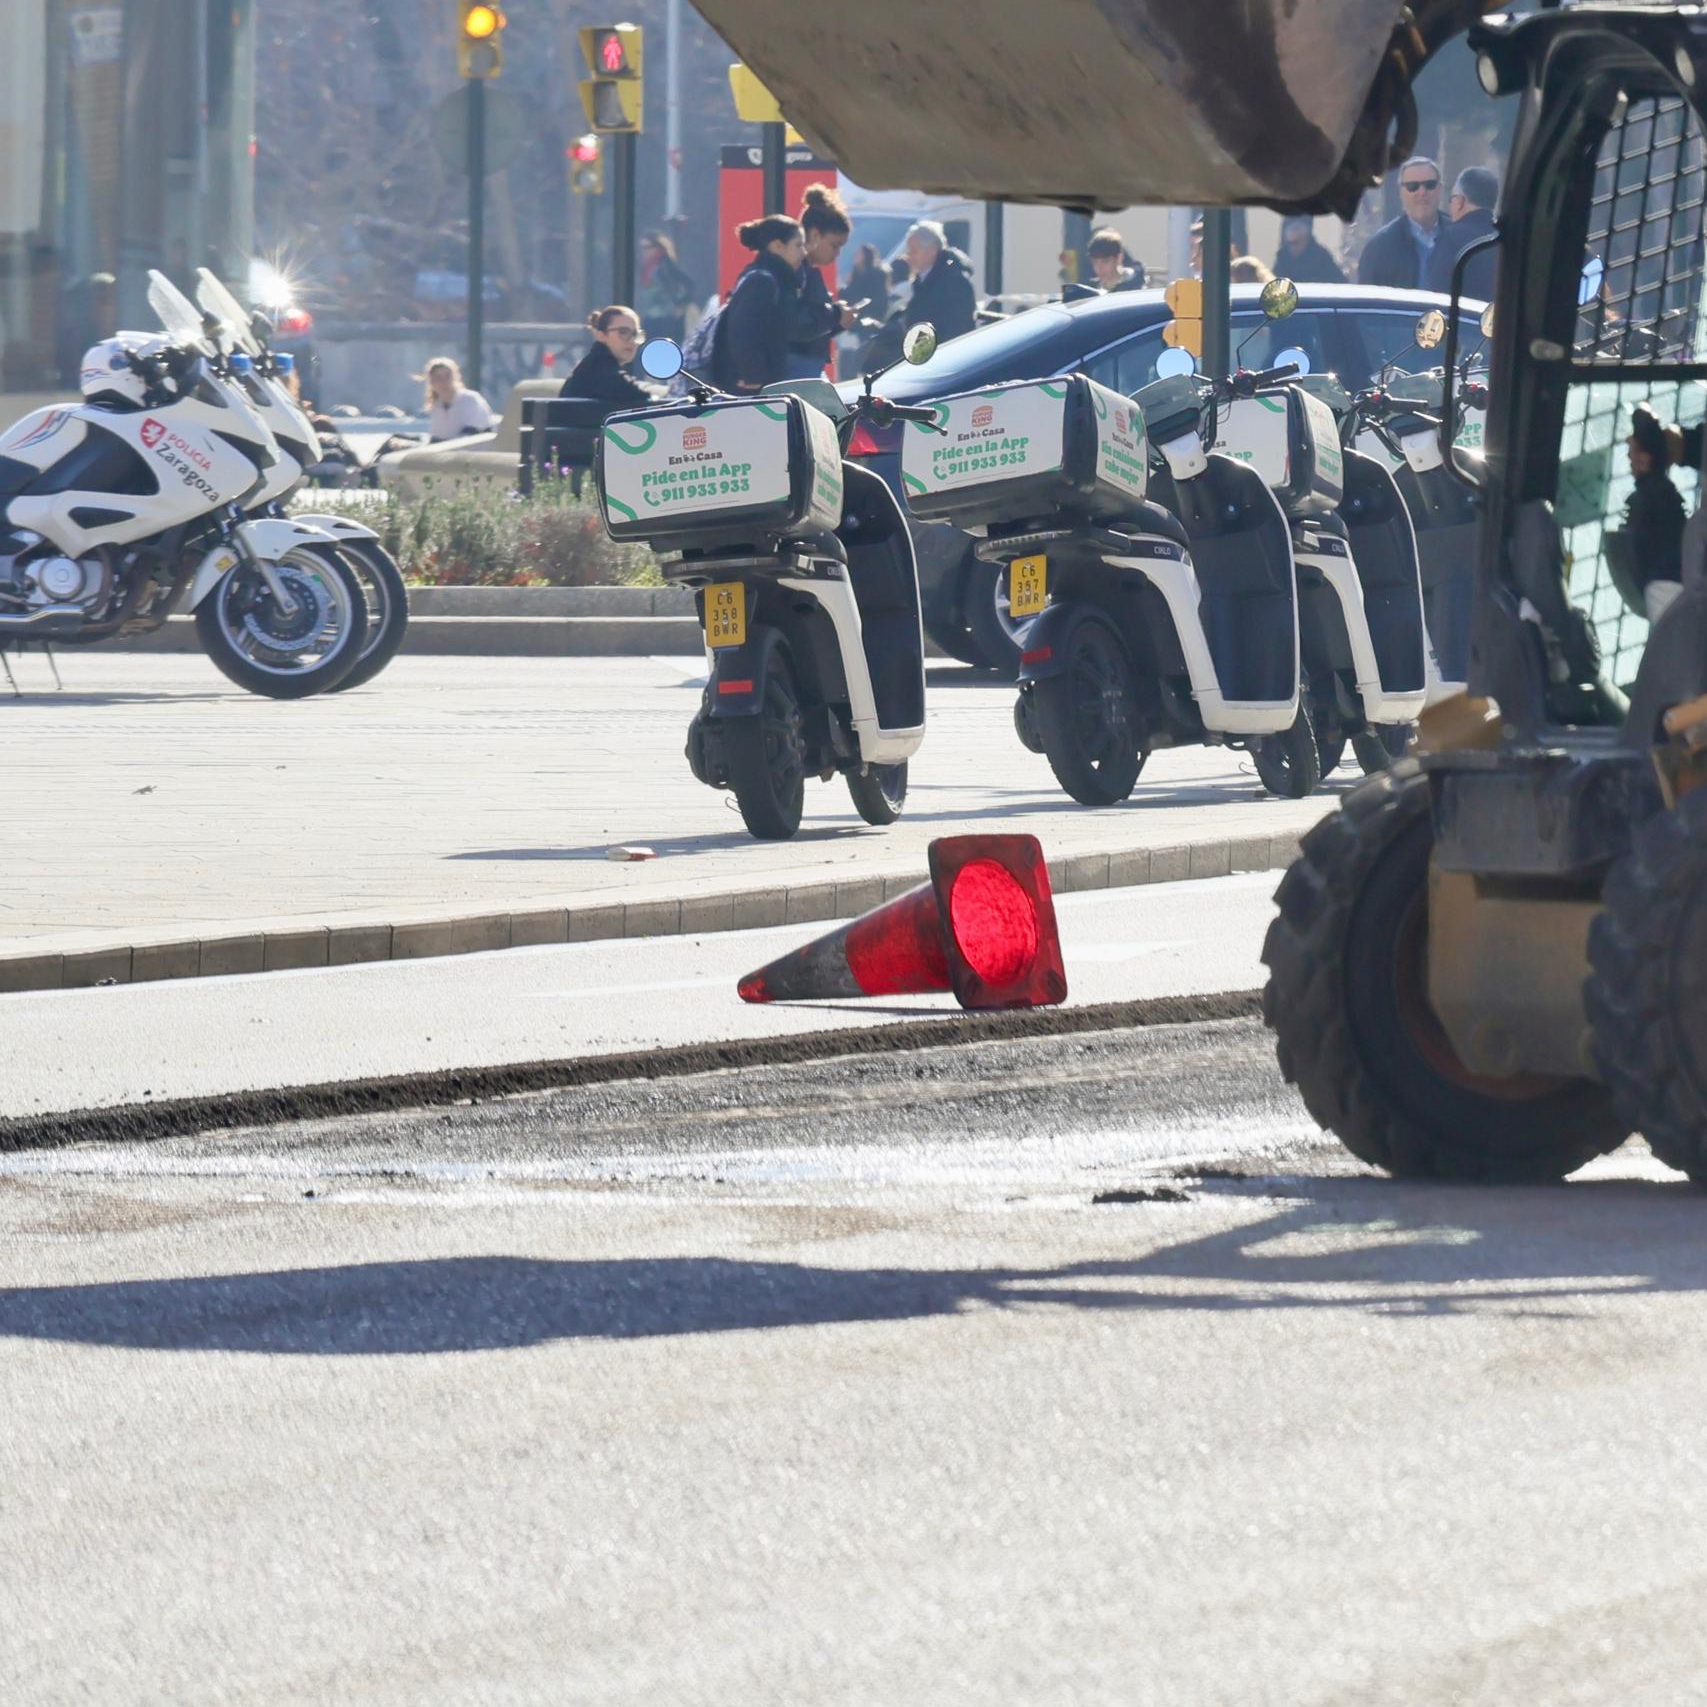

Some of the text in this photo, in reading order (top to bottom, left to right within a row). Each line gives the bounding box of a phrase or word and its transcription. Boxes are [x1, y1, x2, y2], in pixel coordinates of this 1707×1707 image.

[971, 414, 993, 426] KING
[957, 426, 1005, 442] En Casa
[1464, 423, 1482, 436] pp
[682, 436, 707, 448] KING
[932, 436, 1029, 462] Pide en la App
[168, 433, 212, 472] POLICIA
[668, 450, 723, 466] En Casa
[948, 450, 1026, 475] 911 933 933
[156, 442, 220, 502] Zaragoza
[641, 462, 752, 488] Pide en la App
[661, 479, 751, 502] 911 933 933
[1021, 564, 1036, 578] C6
[1017, 578, 1039, 593] 357
[717, 592, 733, 606] C6
[713, 607, 737, 622] 358
